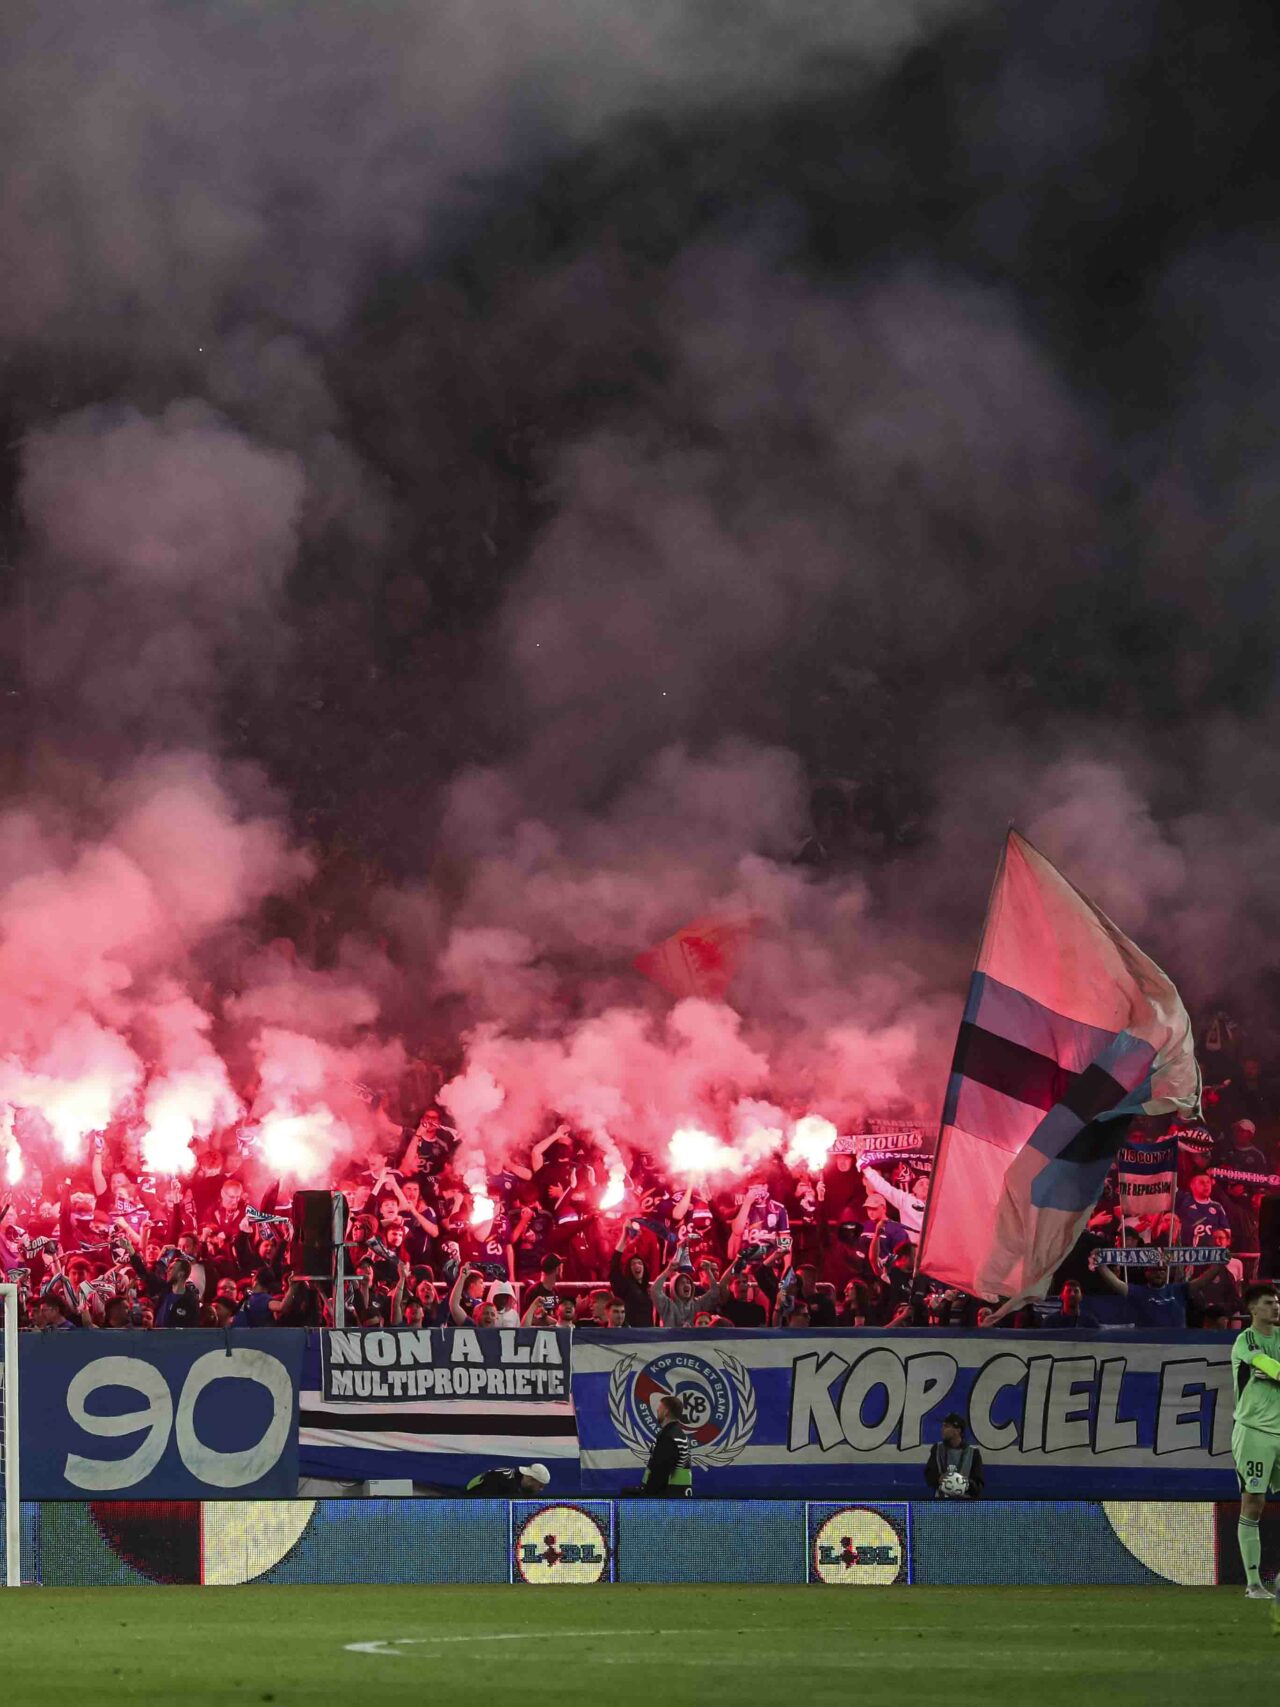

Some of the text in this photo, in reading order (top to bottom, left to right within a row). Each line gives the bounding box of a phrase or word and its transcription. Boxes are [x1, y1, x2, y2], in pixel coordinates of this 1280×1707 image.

[328, 1328, 564, 1367] NON A LA
[330, 1366, 565, 1397] MULTIPROPRIETE
[787, 1346, 959, 1452] KOP
[968, 1352, 1138, 1454] CIEL
[63, 1347, 294, 1492] 90
[1246, 1460, 1263, 1479] 39
